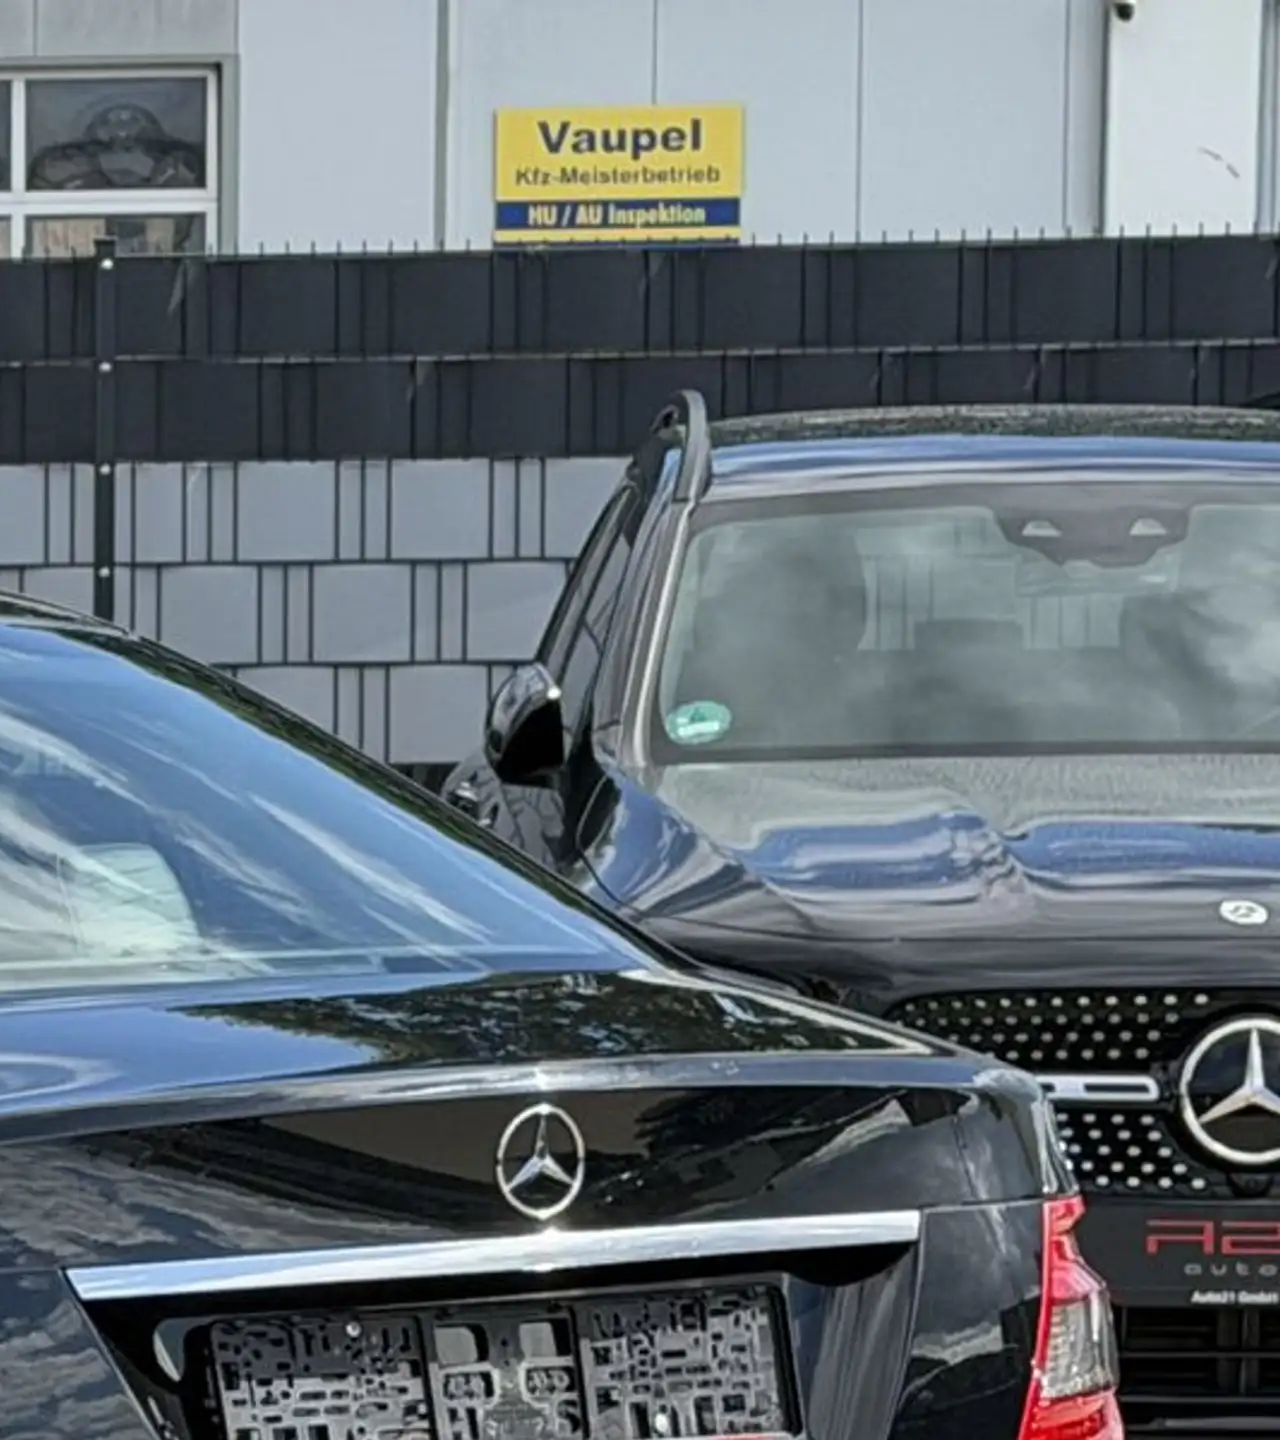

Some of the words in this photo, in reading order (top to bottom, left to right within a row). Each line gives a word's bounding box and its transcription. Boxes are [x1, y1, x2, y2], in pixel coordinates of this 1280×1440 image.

[537, 117, 702, 160] Vaupel
[515, 164, 721, 186] Kfz-Meisterbetrieb
[528, 204, 558, 225] HU
[561, 204, 571, 227] /
[575, 203, 603, 225] AU
[608, 203, 706, 228] Inspektion
